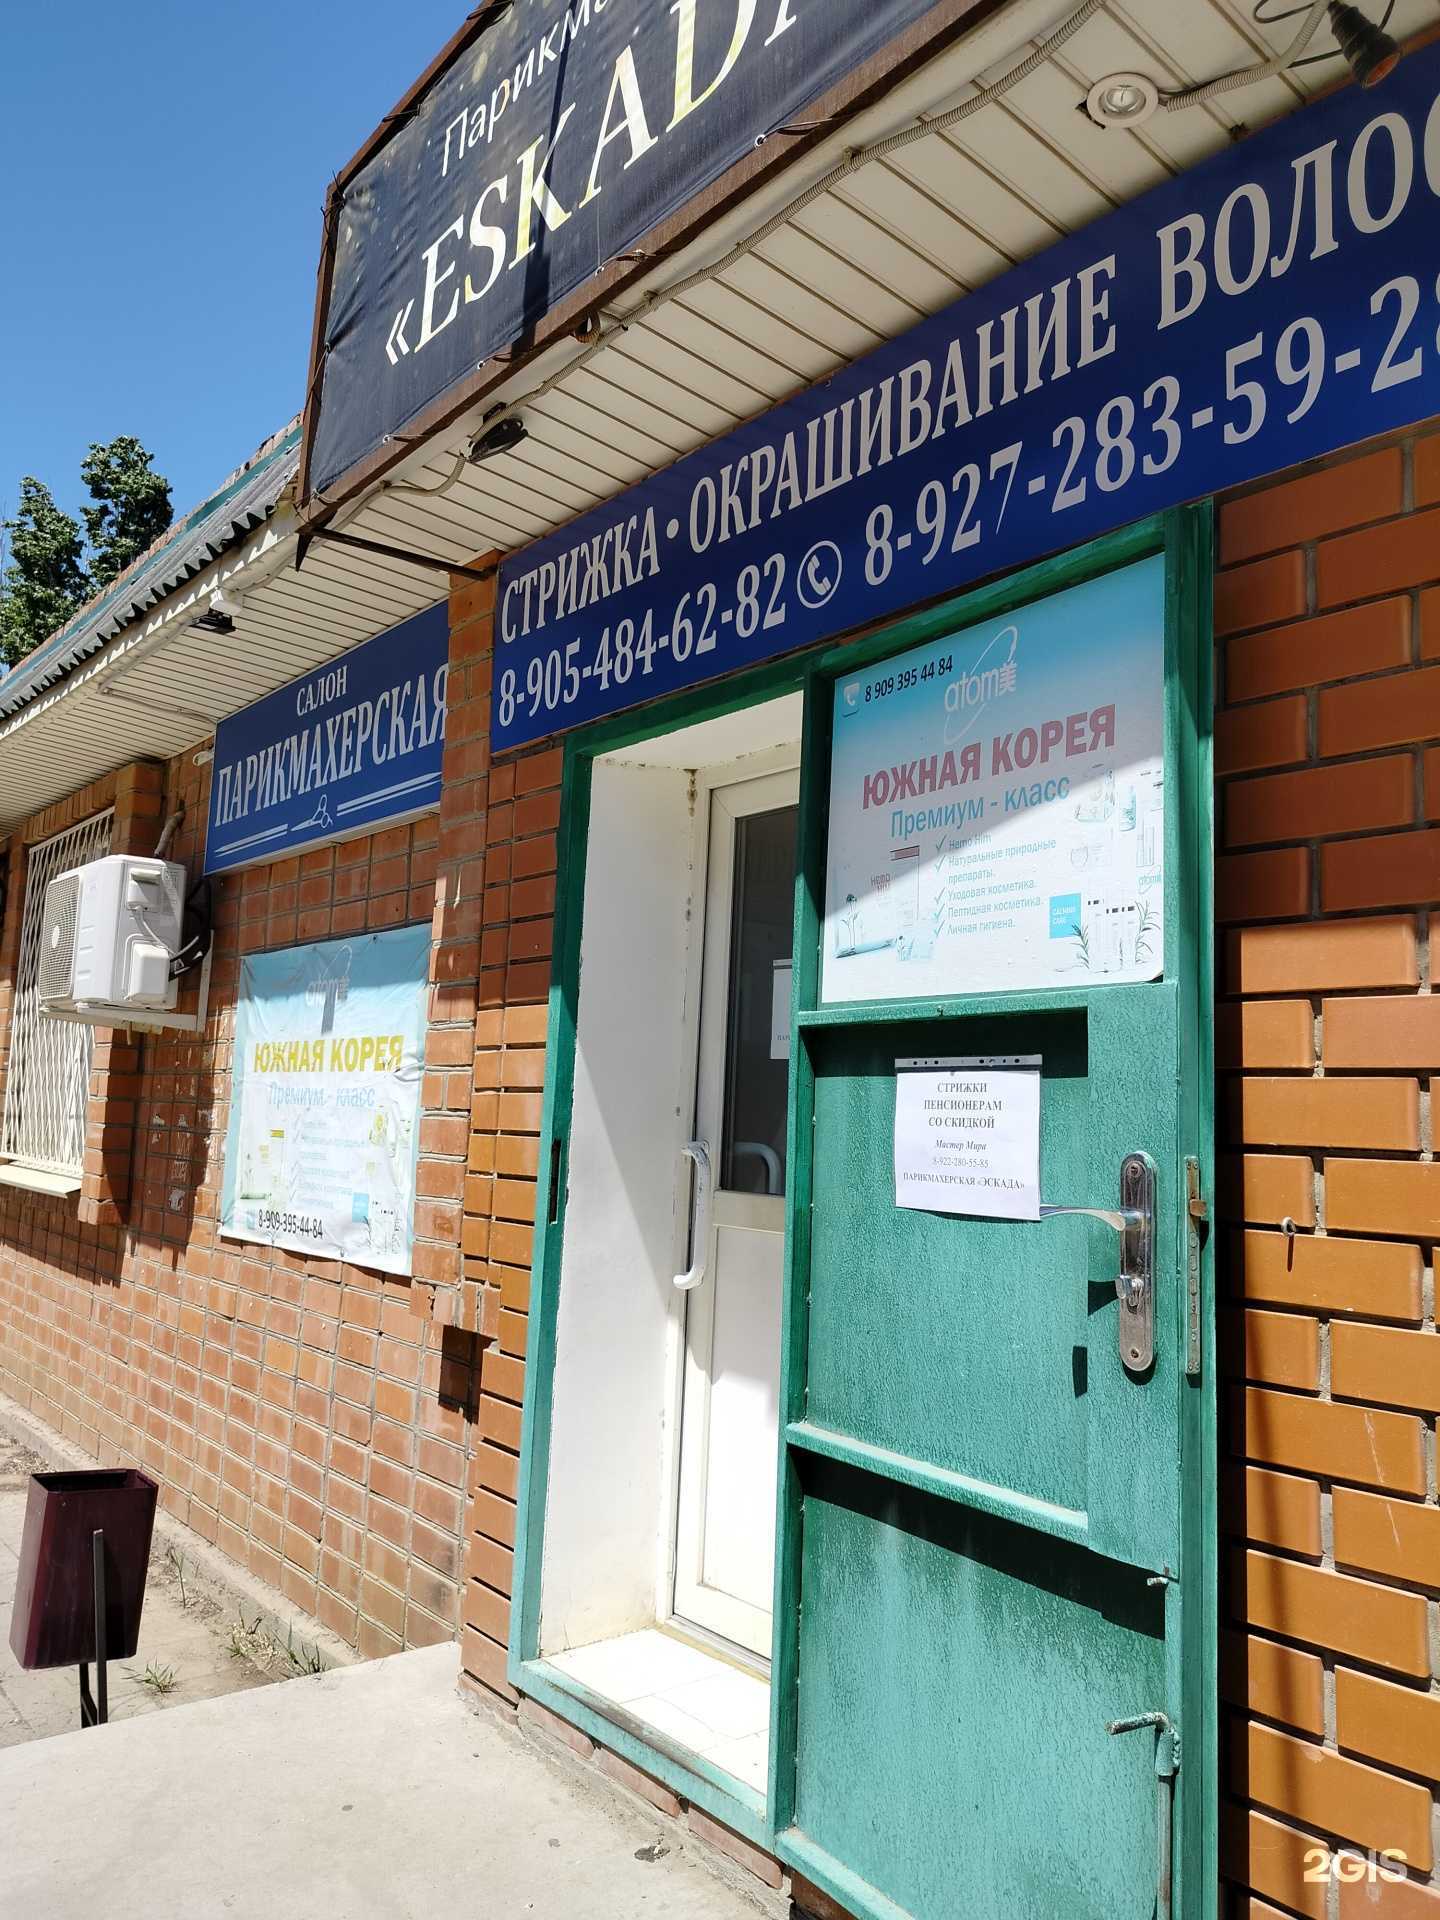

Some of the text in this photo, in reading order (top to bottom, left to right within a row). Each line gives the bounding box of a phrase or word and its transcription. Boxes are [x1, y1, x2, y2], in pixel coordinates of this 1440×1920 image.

[384, 0, 797, 366] «ESKAD
[501, 92, 1440, 644] СТРИЖКА ОКРАШИВАНИЕ ВОЛО
[865, 272, 1440, 587] 8-927-283-59-2
[498, 552, 786, 728] 8-905-484-62-82
[296, 664, 349, 717] САЛОН
[864, 654, 953, 703] 8 909 395 44 84
[214, 662, 449, 828] ПАРИКМАХЕРСКАЯ
[862, 703, 1117, 810] ЮЖНАЯ КОРЕЯ
[890, 796, 984, 841] Премиум
[1004, 776, 1070, 812] класс
[1005, 839, 1057, 857] природные
[254, 1035, 405, 1073] ЮЖНАЯ КОРЕЯ
[268, 1083, 325, 1108] Премиум
[336, 1086, 376, 1108] класс
[924, 1099, 1002, 1111] ПЕНСИОНЕРАМ
[937, 1082, 987, 1093] СТРИЖКИ
[928, 1116, 995, 1128] СО СКИДКОЙ
[935, 1139, 964, 1152] Мастер
[903, 1172, 975, 1186] ПАРИКМАХЕРСКАЯ
[258, 1209, 323, 1239] 8-909-395-44-84
